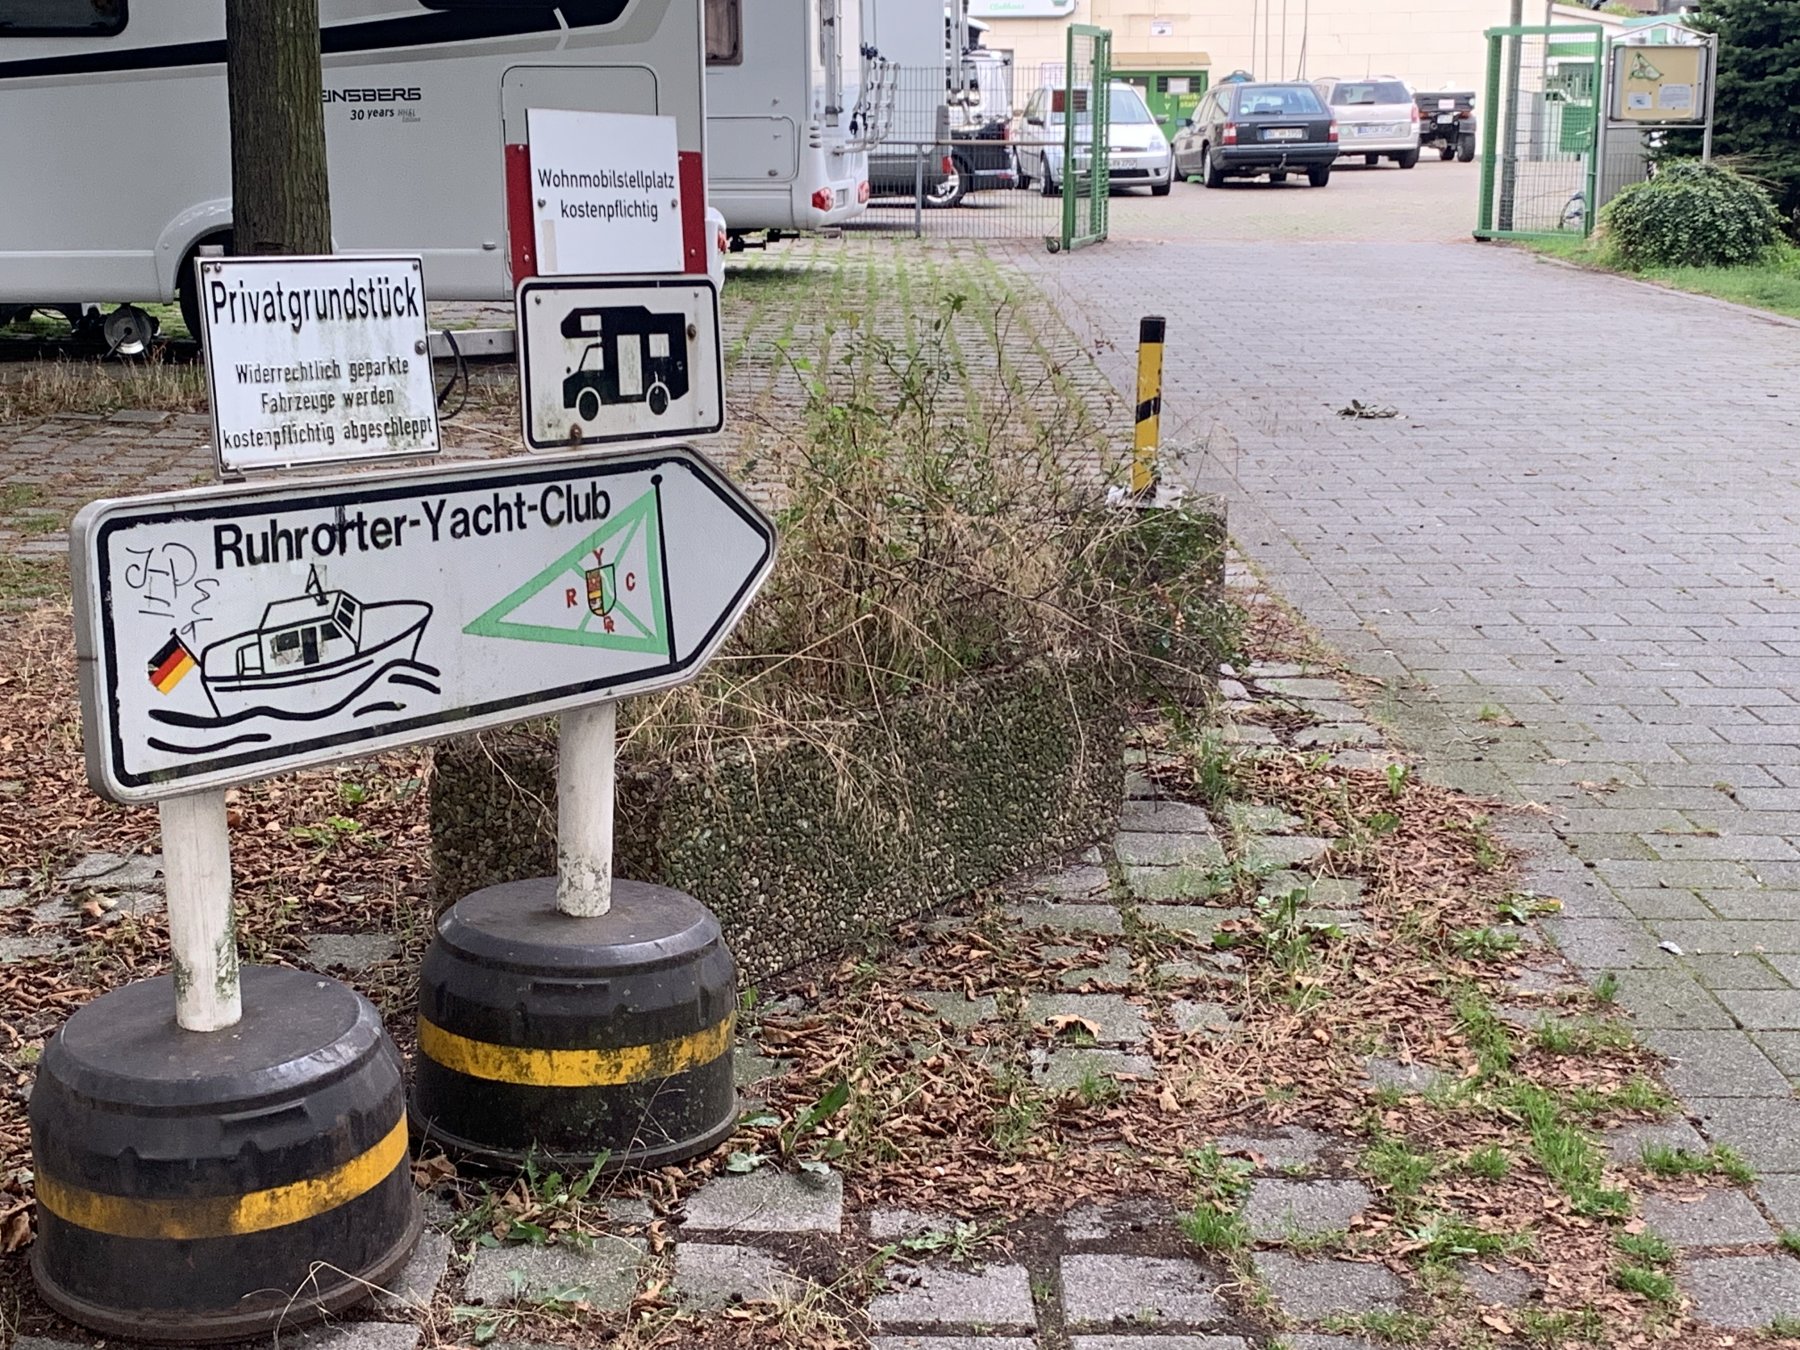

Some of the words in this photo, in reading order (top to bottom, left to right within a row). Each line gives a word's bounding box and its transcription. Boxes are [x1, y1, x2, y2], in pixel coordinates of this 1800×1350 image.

[350, 109, 364, 120] 30
[367, 109, 394, 119] years
[538, 168, 675, 193] Wohnmobilstellplatz
[560, 199, 658, 222] kostenpflichtig
[211, 277, 419, 334] Privatgrundstück
[235, 360, 342, 384] Widerrechtlich
[349, 355, 409, 383] geparkte
[261, 392, 336, 414] Fahrzeuge
[343, 386, 395, 408] werden
[223, 421, 336, 450] kostenpflichtig
[343, 415, 433, 443] abgeschleppt
[213, 481, 612, 569] Ruhrorter-Yacht-Club
[592, 547, 604, 566] Y
[566, 588, 578, 608] R
[625, 572, 636, 591] C
